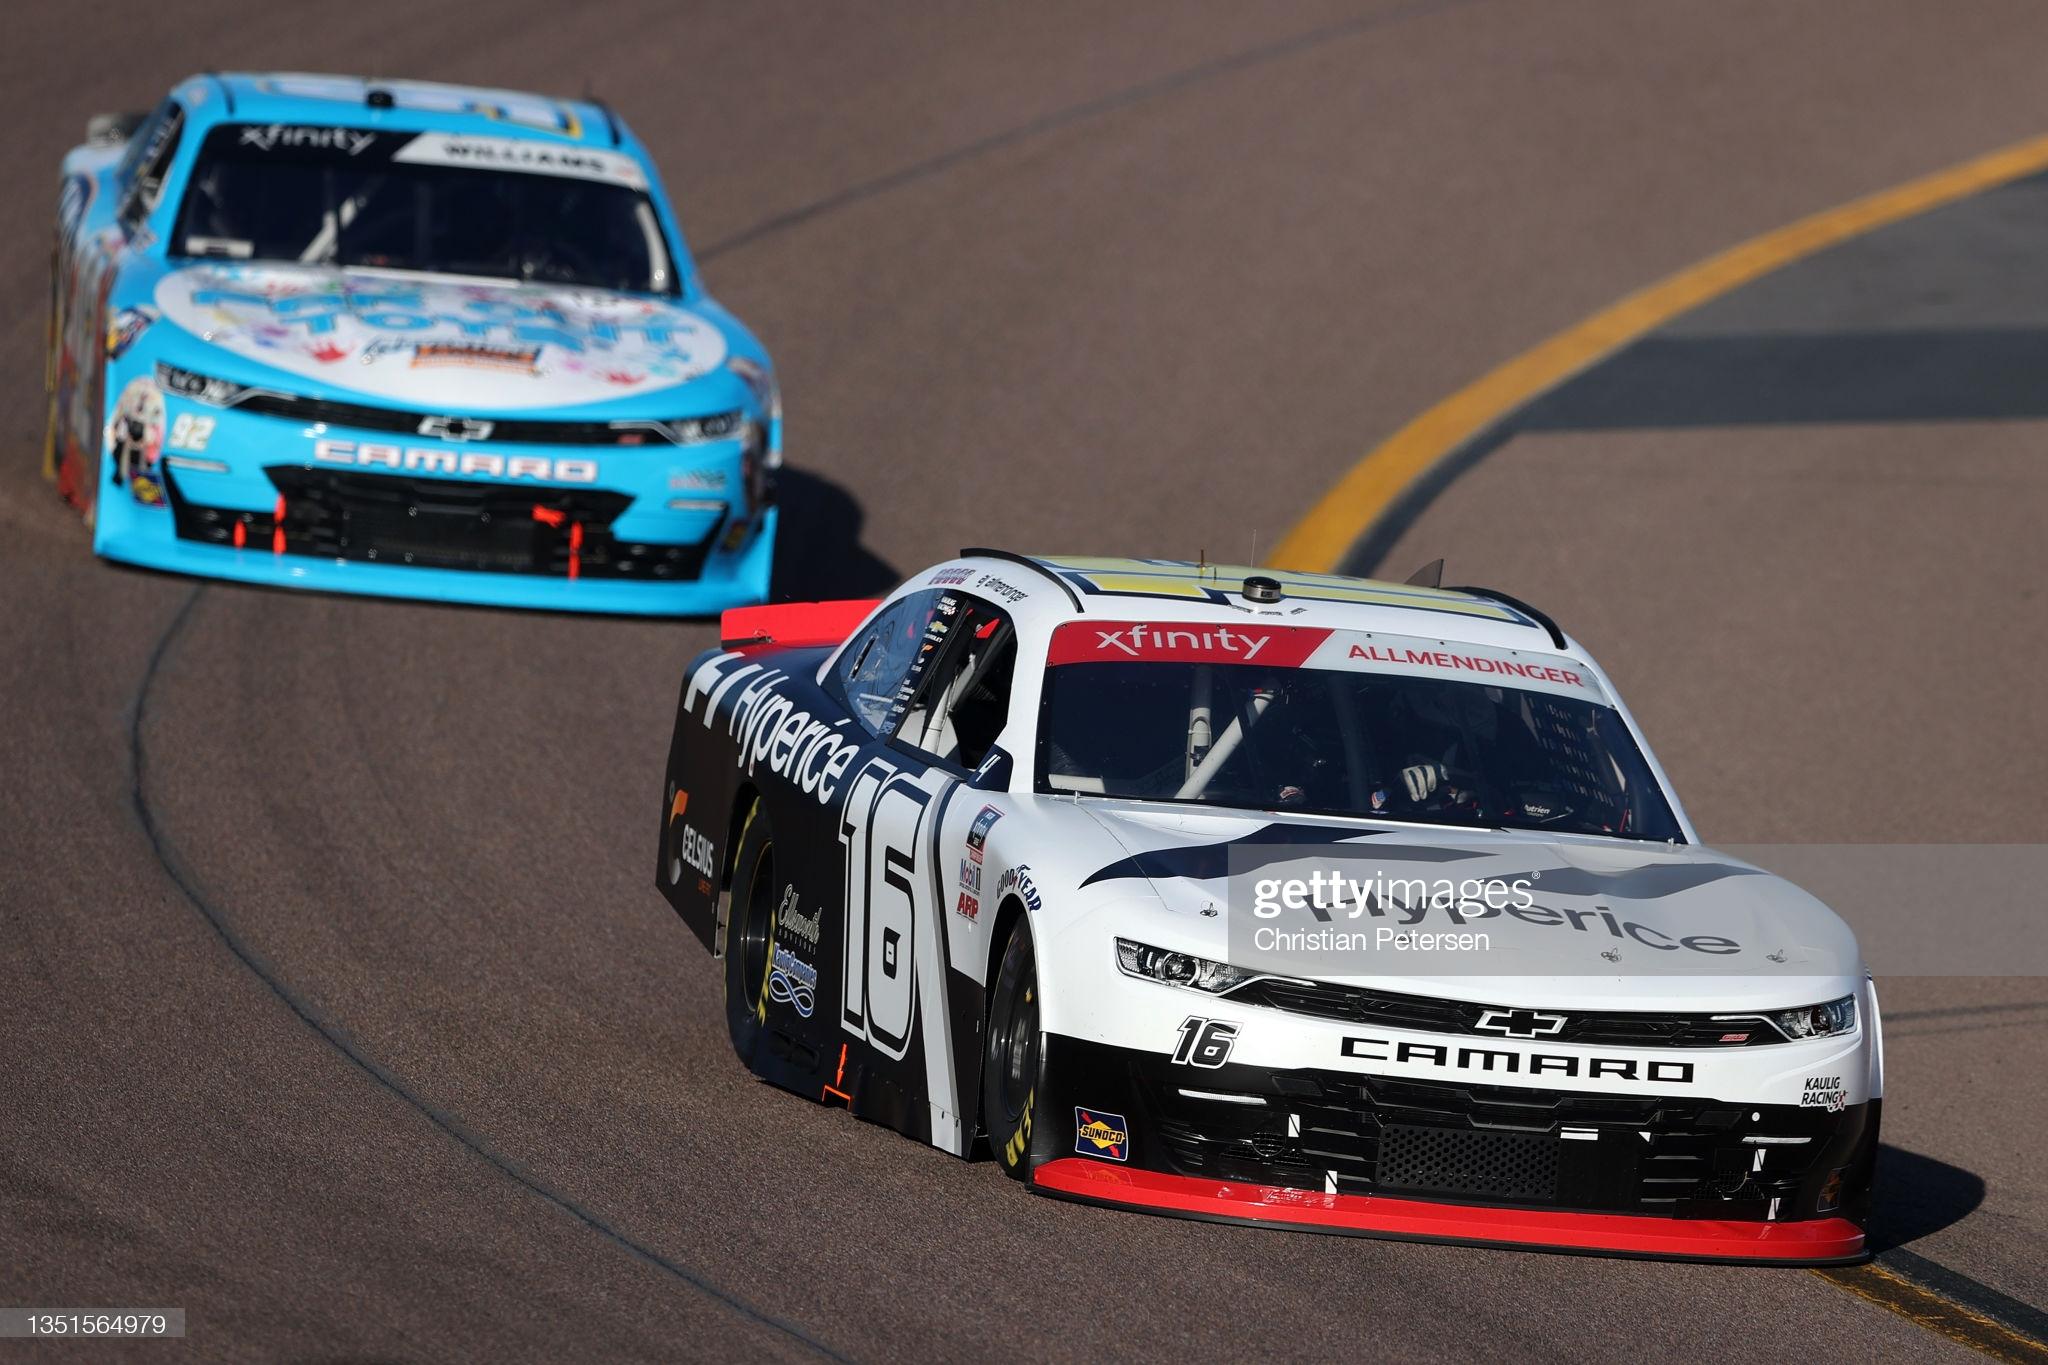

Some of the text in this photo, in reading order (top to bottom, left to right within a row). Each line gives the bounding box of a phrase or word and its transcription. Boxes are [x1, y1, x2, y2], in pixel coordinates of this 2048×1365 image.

[239, 122, 378, 156] xfinity
[442, 142, 605, 172] WILLIAMS
[169, 411, 217, 450] 92
[313, 438, 598, 484] CAMARO
[1095, 624, 1271, 660] xfinity
[1347, 645, 1584, 689] ALLMENDINGER
[728, 668, 860, 805] Hyperice
[682, 823, 714, 878] CELSIUS
[838, 756, 934, 1062] 16
[956, 891, 980, 920] ARP
[1171, 1015, 1243, 1069] 16
[1340, 1036, 1695, 1084] CAMARO
[1801, 1091, 1839, 1105] RACING
[1804, 1076, 1840, 1090] KAULIG
[1081, 1125, 1123, 1143] SUNOCO
